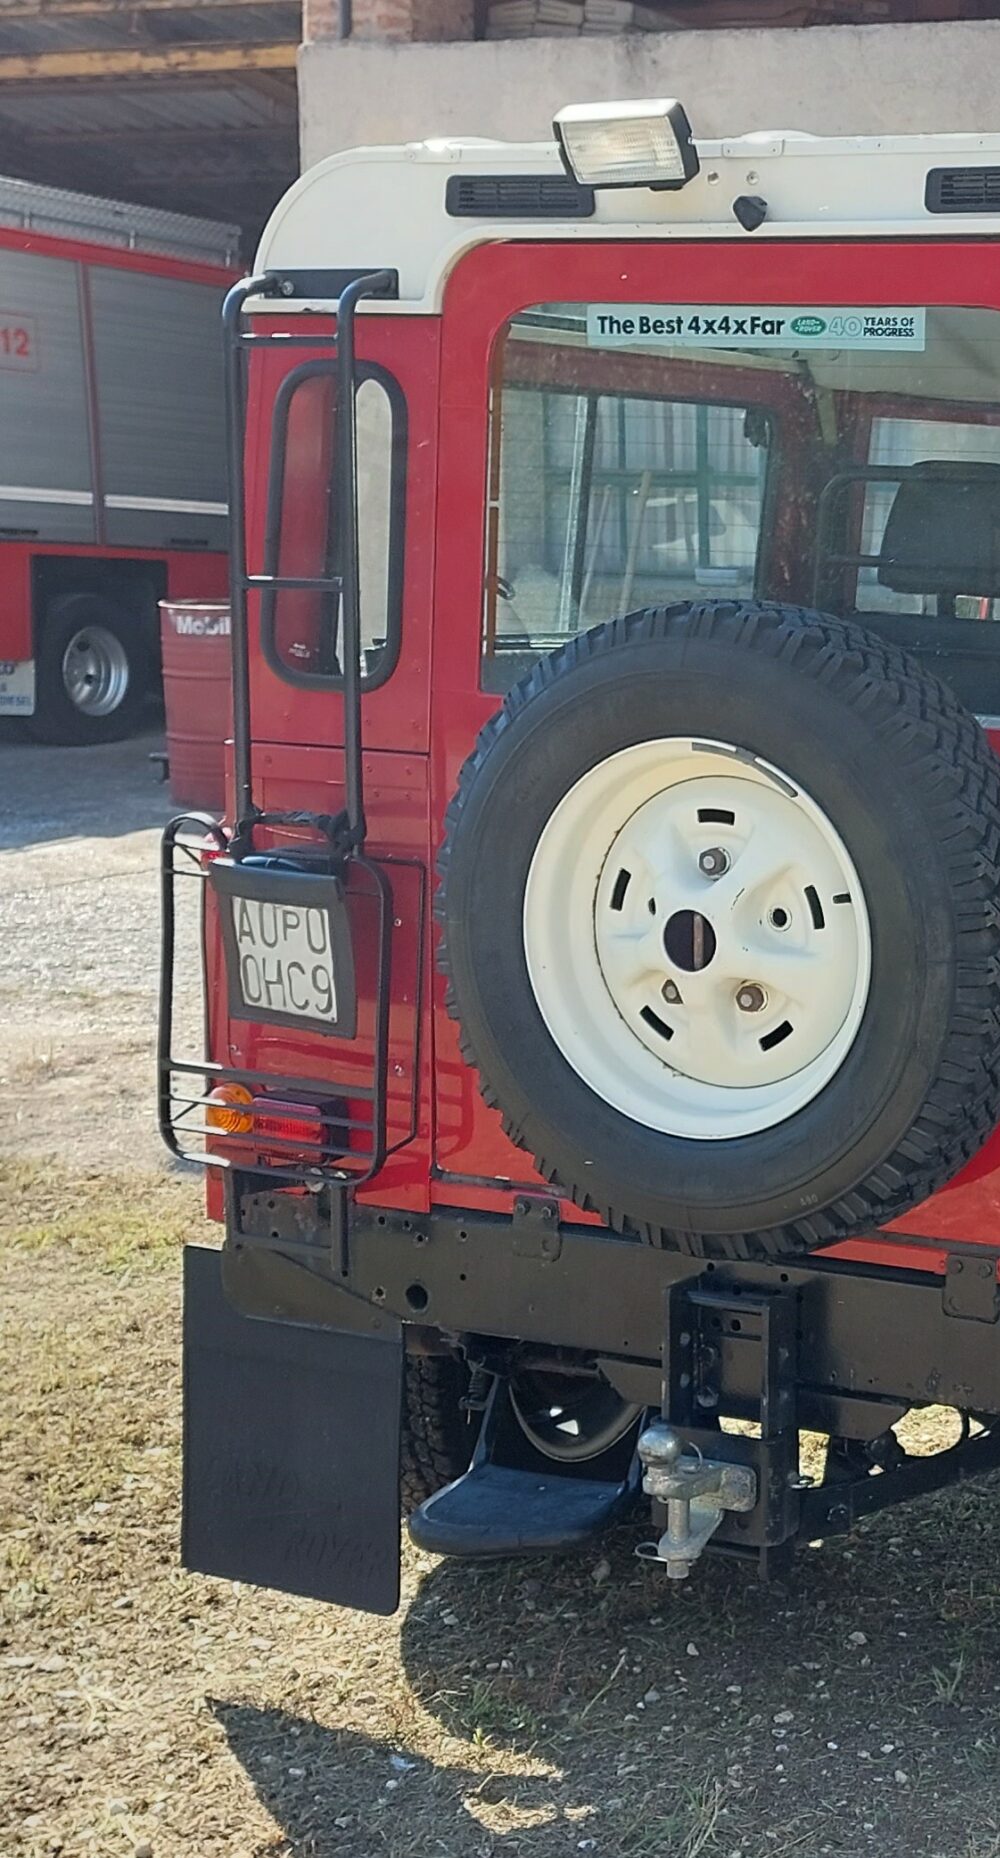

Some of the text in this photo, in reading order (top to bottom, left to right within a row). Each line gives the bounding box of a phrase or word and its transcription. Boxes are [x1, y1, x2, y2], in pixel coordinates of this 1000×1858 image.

[596, 315, 786, 335] The Best 4x4xFar
[828, 315, 862, 337] 40
[863, 316, 915, 327] YEARS OF
[863, 327, 915, 337] PROGRESS
[176, 615, 232, 636] Mobil
